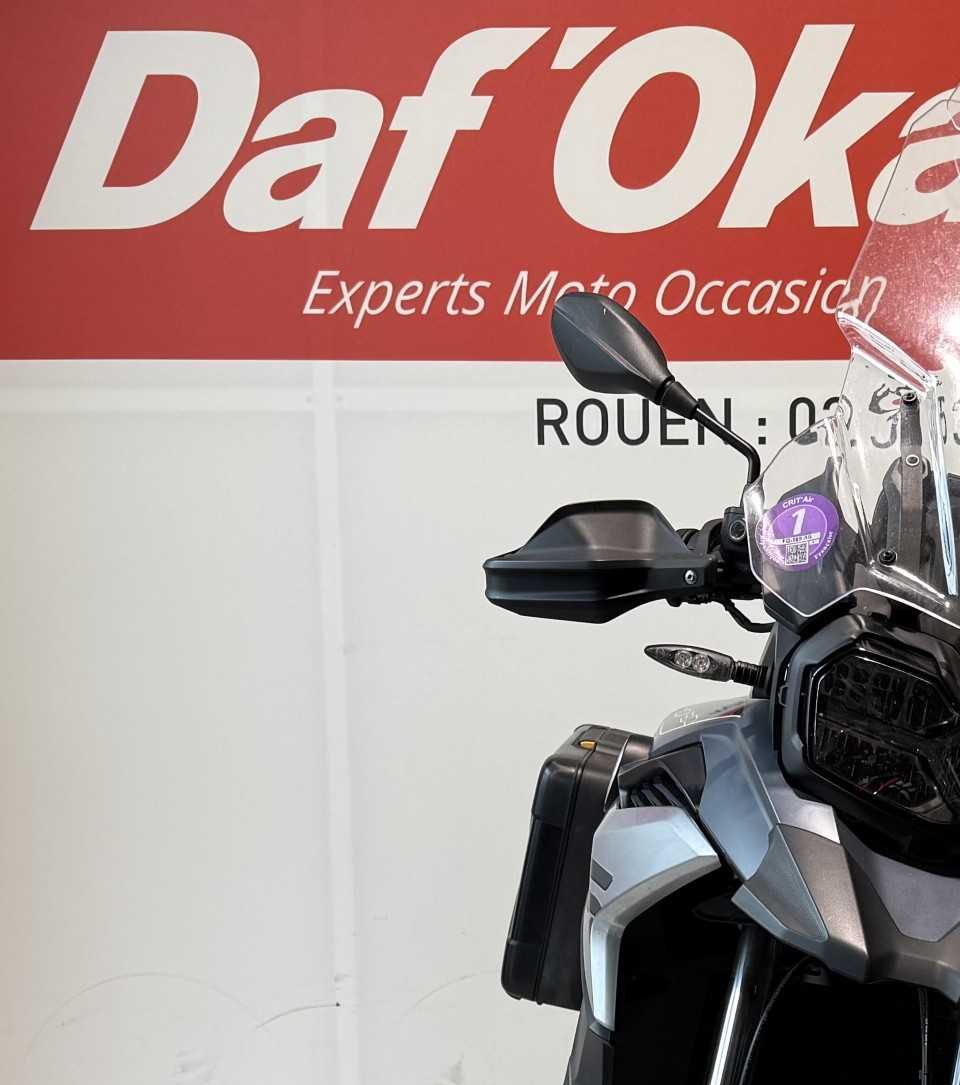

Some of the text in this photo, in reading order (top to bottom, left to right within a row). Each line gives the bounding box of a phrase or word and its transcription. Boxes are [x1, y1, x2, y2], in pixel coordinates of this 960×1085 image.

[302, 270, 492, 329] Experts
[655, 268, 887, 325] Occasion
[536, 397, 732, 446] ROUEN
[791, 508, 806, 536] 1
